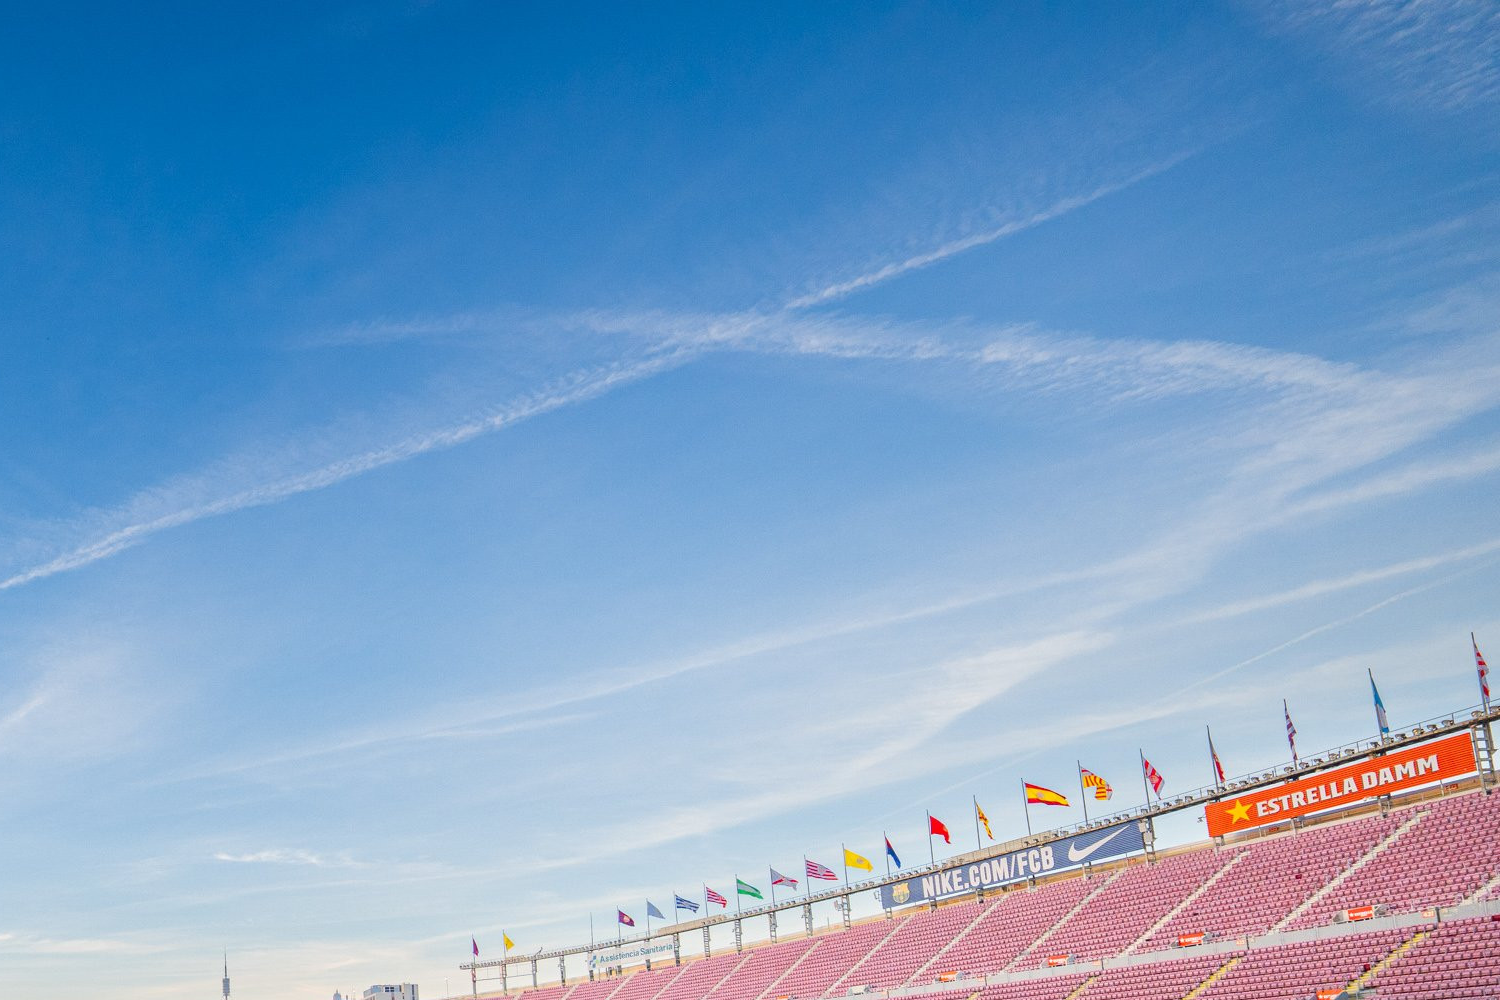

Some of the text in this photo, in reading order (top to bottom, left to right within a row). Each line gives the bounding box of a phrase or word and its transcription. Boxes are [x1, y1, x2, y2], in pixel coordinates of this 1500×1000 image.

[1256, 754, 1440, 818] ESTRELLA DAMM
[922, 845, 1055, 899] NIKE.COM/FCB
